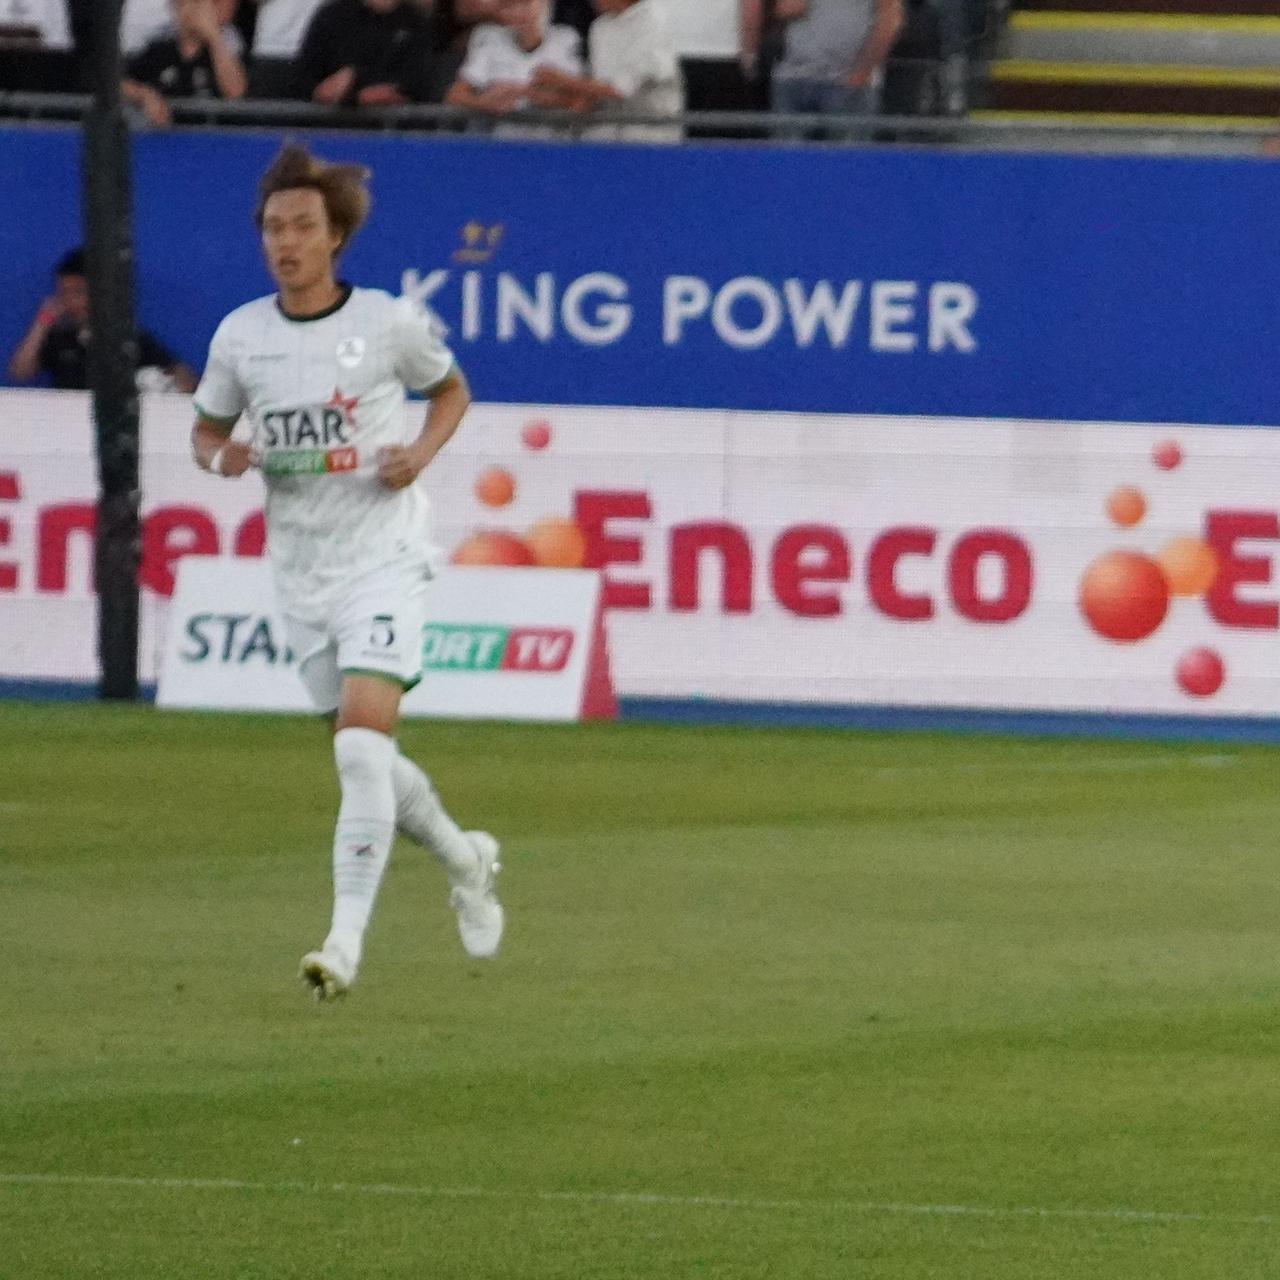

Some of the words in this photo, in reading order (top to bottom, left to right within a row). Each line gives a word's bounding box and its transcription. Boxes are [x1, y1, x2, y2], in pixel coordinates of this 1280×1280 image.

[661, 275, 979, 353] POWER
[263, 407, 348, 447] STAR
[575, 488, 1035, 624] Eneco
[180, 612, 298, 666] STA
[514, 635, 567, 666] TV
